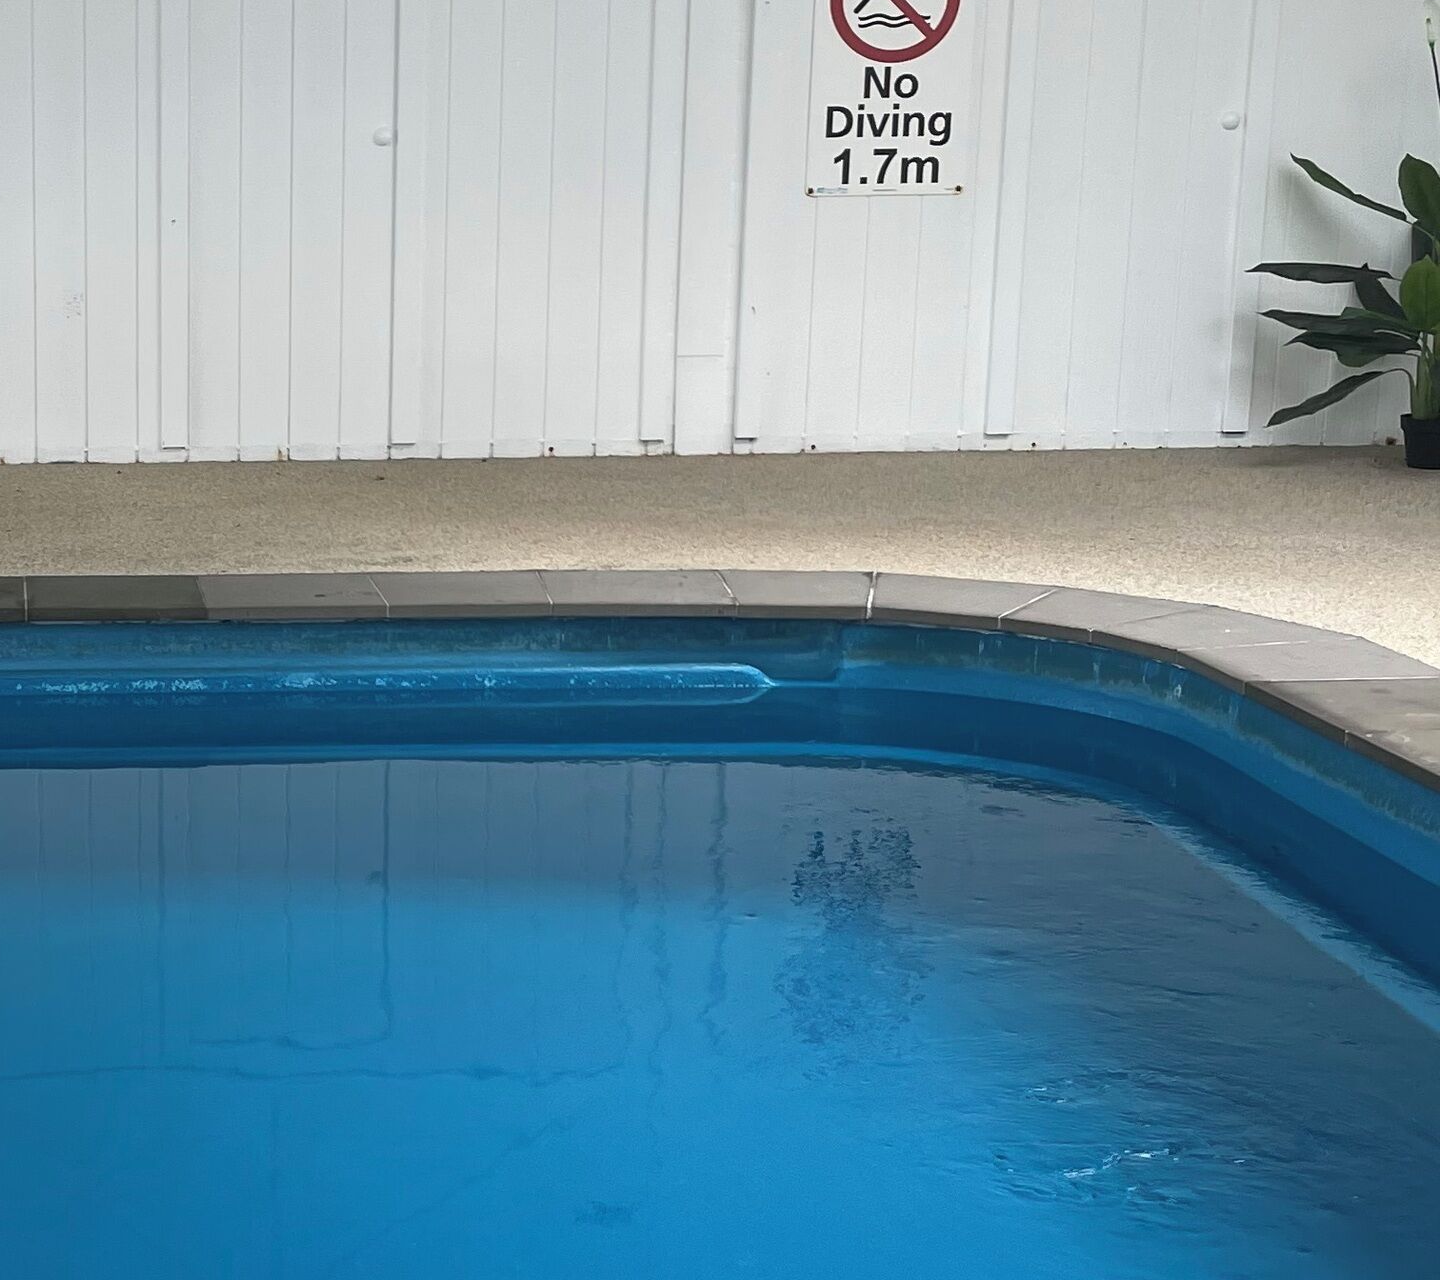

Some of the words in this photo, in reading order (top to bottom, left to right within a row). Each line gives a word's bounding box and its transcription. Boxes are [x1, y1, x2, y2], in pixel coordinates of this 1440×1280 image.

[863, 66, 919, 99] No
[825, 104, 952, 146] Diving
[833, 148, 939, 184] 1.7m
